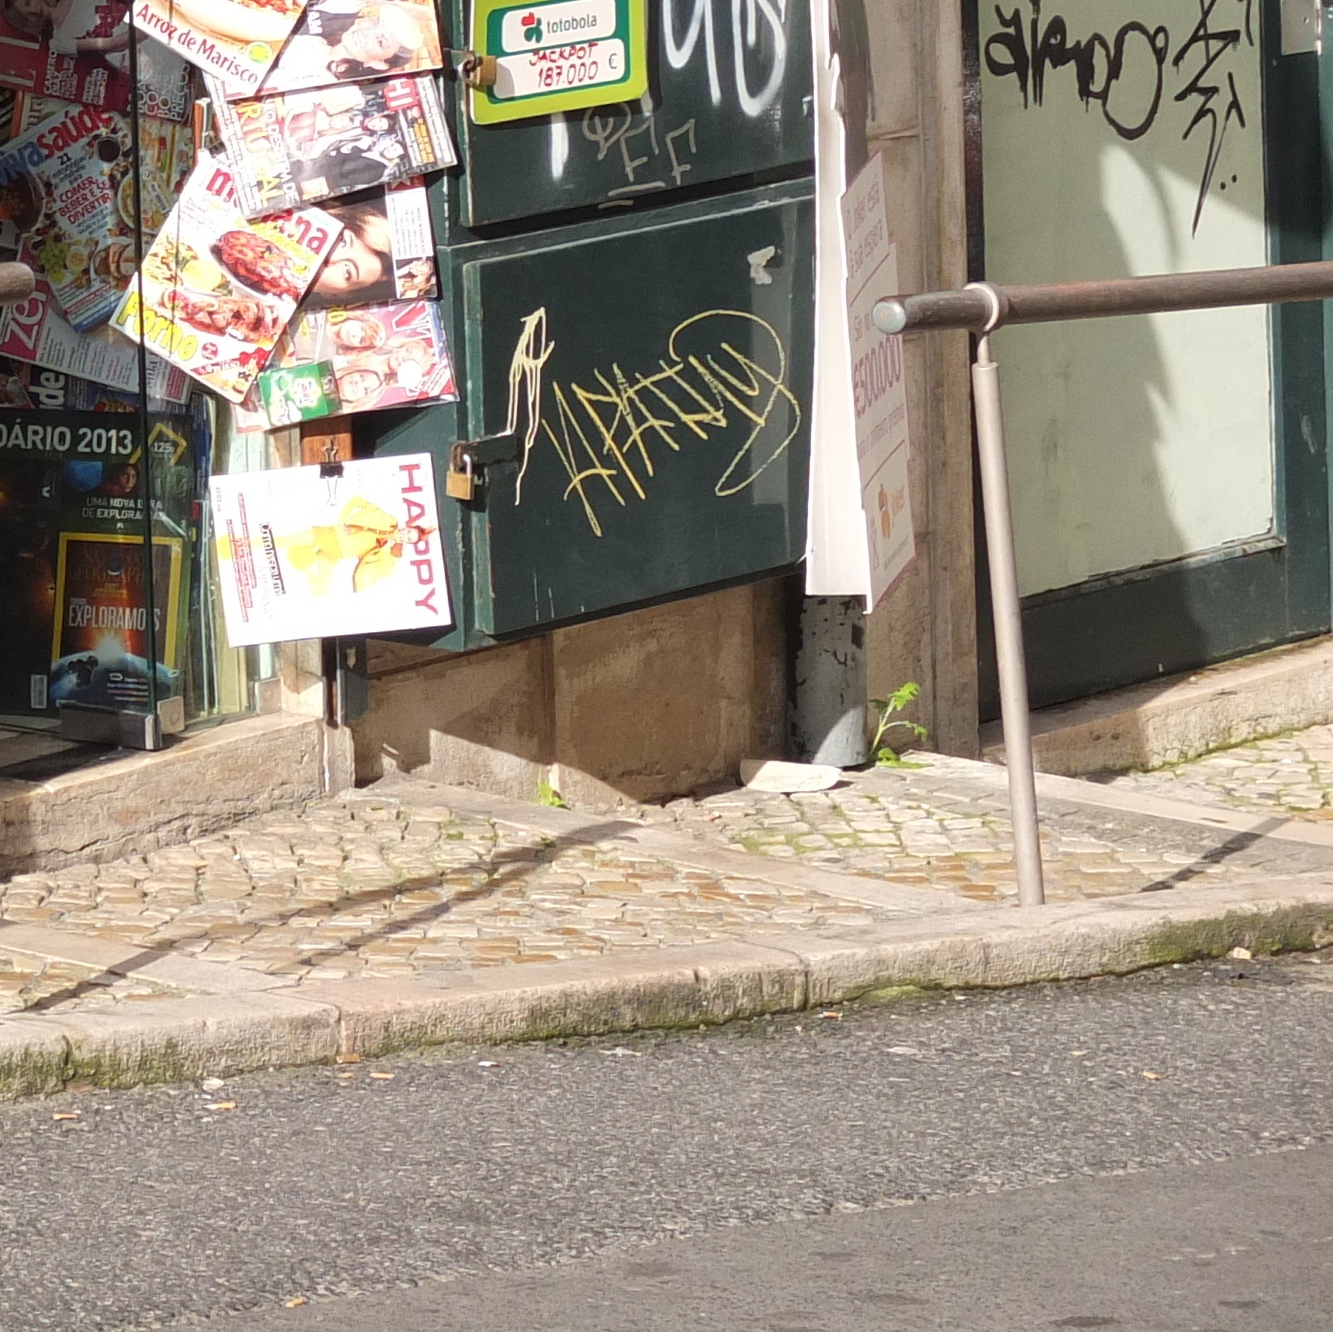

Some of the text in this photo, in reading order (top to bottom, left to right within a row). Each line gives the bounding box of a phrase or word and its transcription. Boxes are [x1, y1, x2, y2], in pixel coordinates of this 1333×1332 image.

[546, 13, 598, 34] totobola
[136, 4, 259, 85] Arroz de Marisco
[529, 42, 599, 67] JACKPOT
[78, 427, 132, 454] 2013
[397, 462, 439, 616] HAPPY
